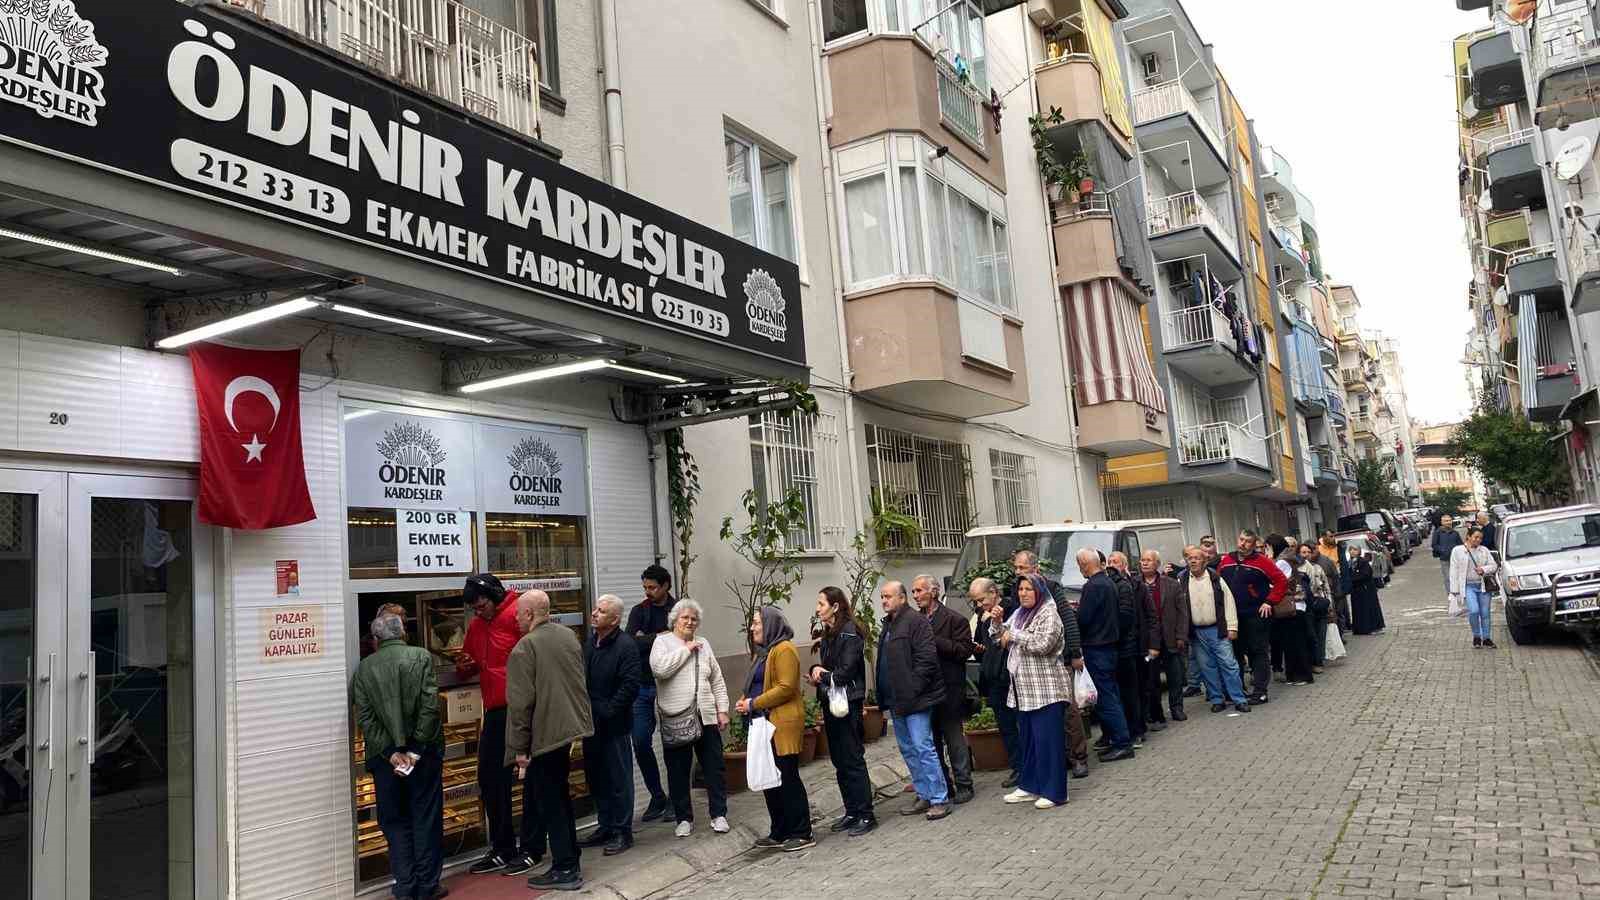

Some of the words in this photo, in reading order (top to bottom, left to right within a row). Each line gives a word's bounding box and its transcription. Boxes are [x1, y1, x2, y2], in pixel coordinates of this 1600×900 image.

[167, 19, 465, 207] ÖDENİR
[486, 158, 727, 298] KARDEŞLER
[198, 152, 248, 188] 212
[262, 172, 294, 202] 33
[309, 189, 335, 214] 13
[366, 200, 489, 267] EKMEK
[507, 244, 644, 313] FABRİKASI
[660, 298, 684, 320] 225
[691, 309, 704, 326] 19
[709, 316, 722, 332] 35
[49, 412, 68, 425] 20
[379, 460, 446, 486] ÖDENİR
[510, 471, 562, 493] ÖDENİR
[384, 487, 443, 503] KARDEŞLER
[514, 494, 560, 509] KARDEŞLER
[406, 511, 431, 524] 200
[436, 512, 457, 524] GR
[409, 533, 461, 545] EKMEK
[414, 555, 431, 567] 10
[435, 555, 454, 567] TL
[276, 612, 308, 624] PAZAR
[269, 624, 316, 641] GÜNLERİ
[265, 643, 320, 657] KAPALIYIZ.
